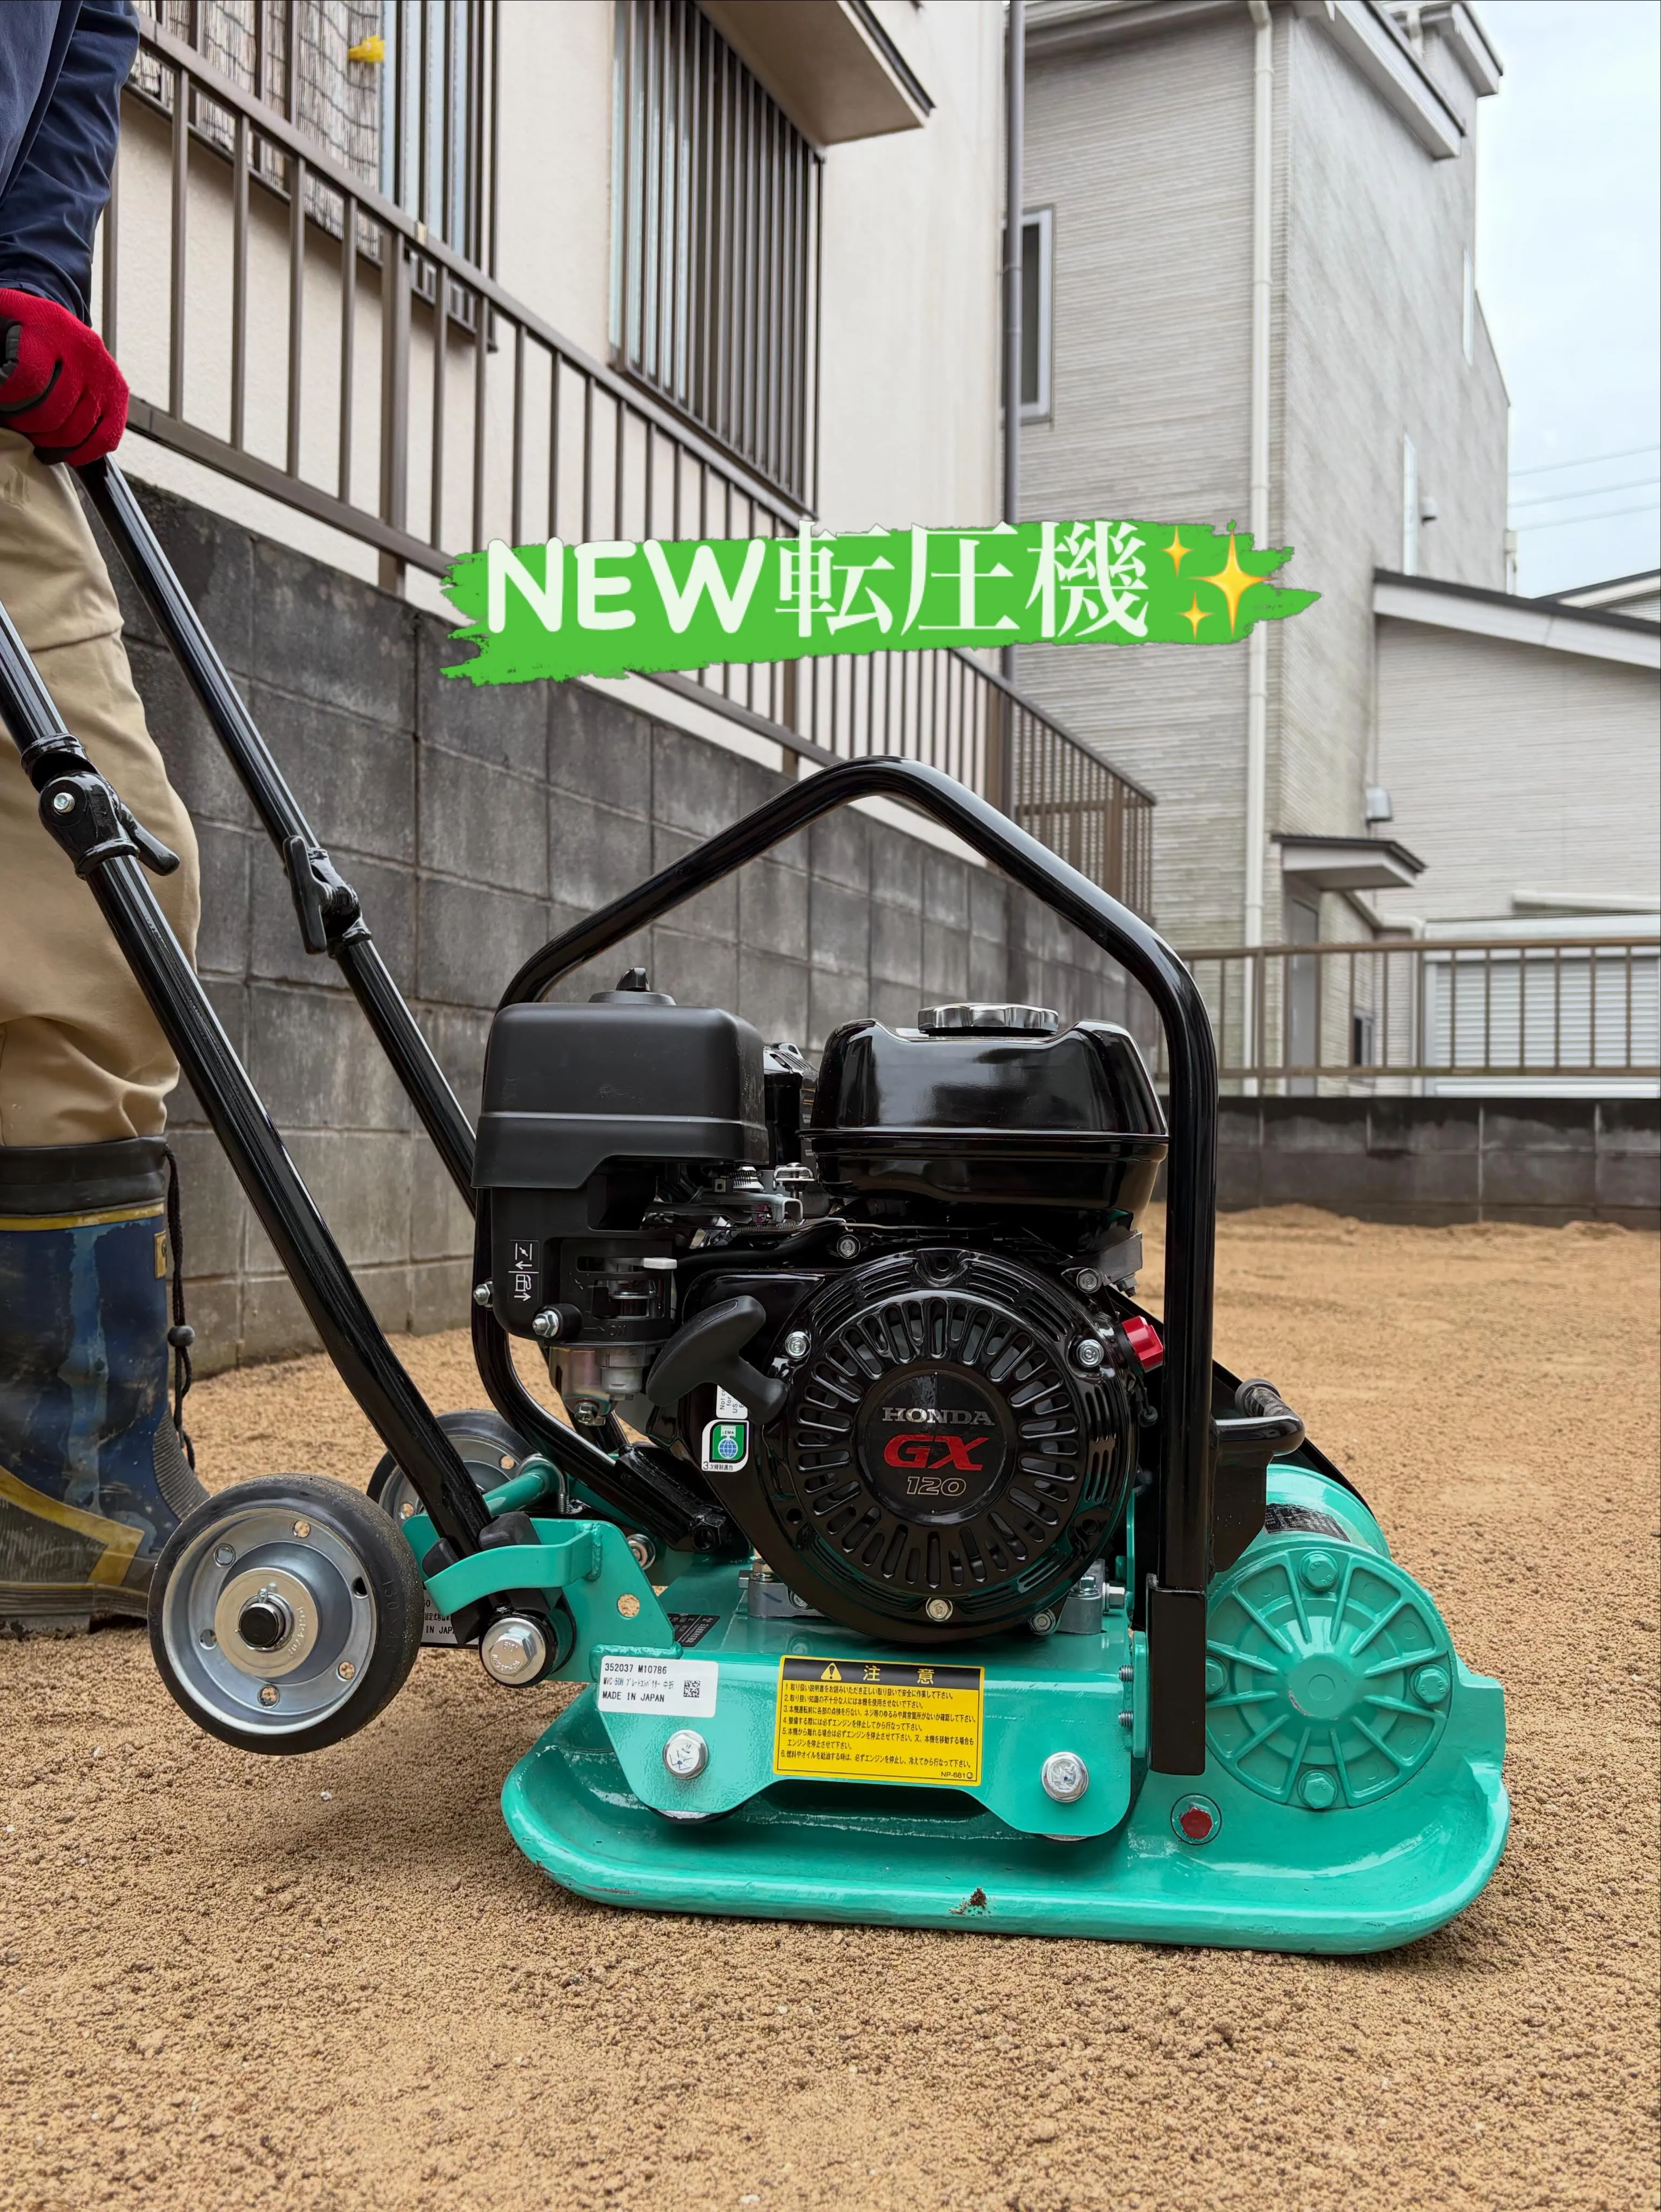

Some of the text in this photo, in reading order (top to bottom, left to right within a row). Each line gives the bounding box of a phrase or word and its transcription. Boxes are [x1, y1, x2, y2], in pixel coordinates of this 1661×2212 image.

[882, 1407, 995, 1426] HONDA
[884, 1434, 990, 1471] GX
[906, 1476, 966, 1496] 120
[426, 1626, 454, 1634] IN JAP
[605, 1663, 667, 1674] 352037 M10786
[602, 1691, 665, 1702] MADE IN JAPAN
